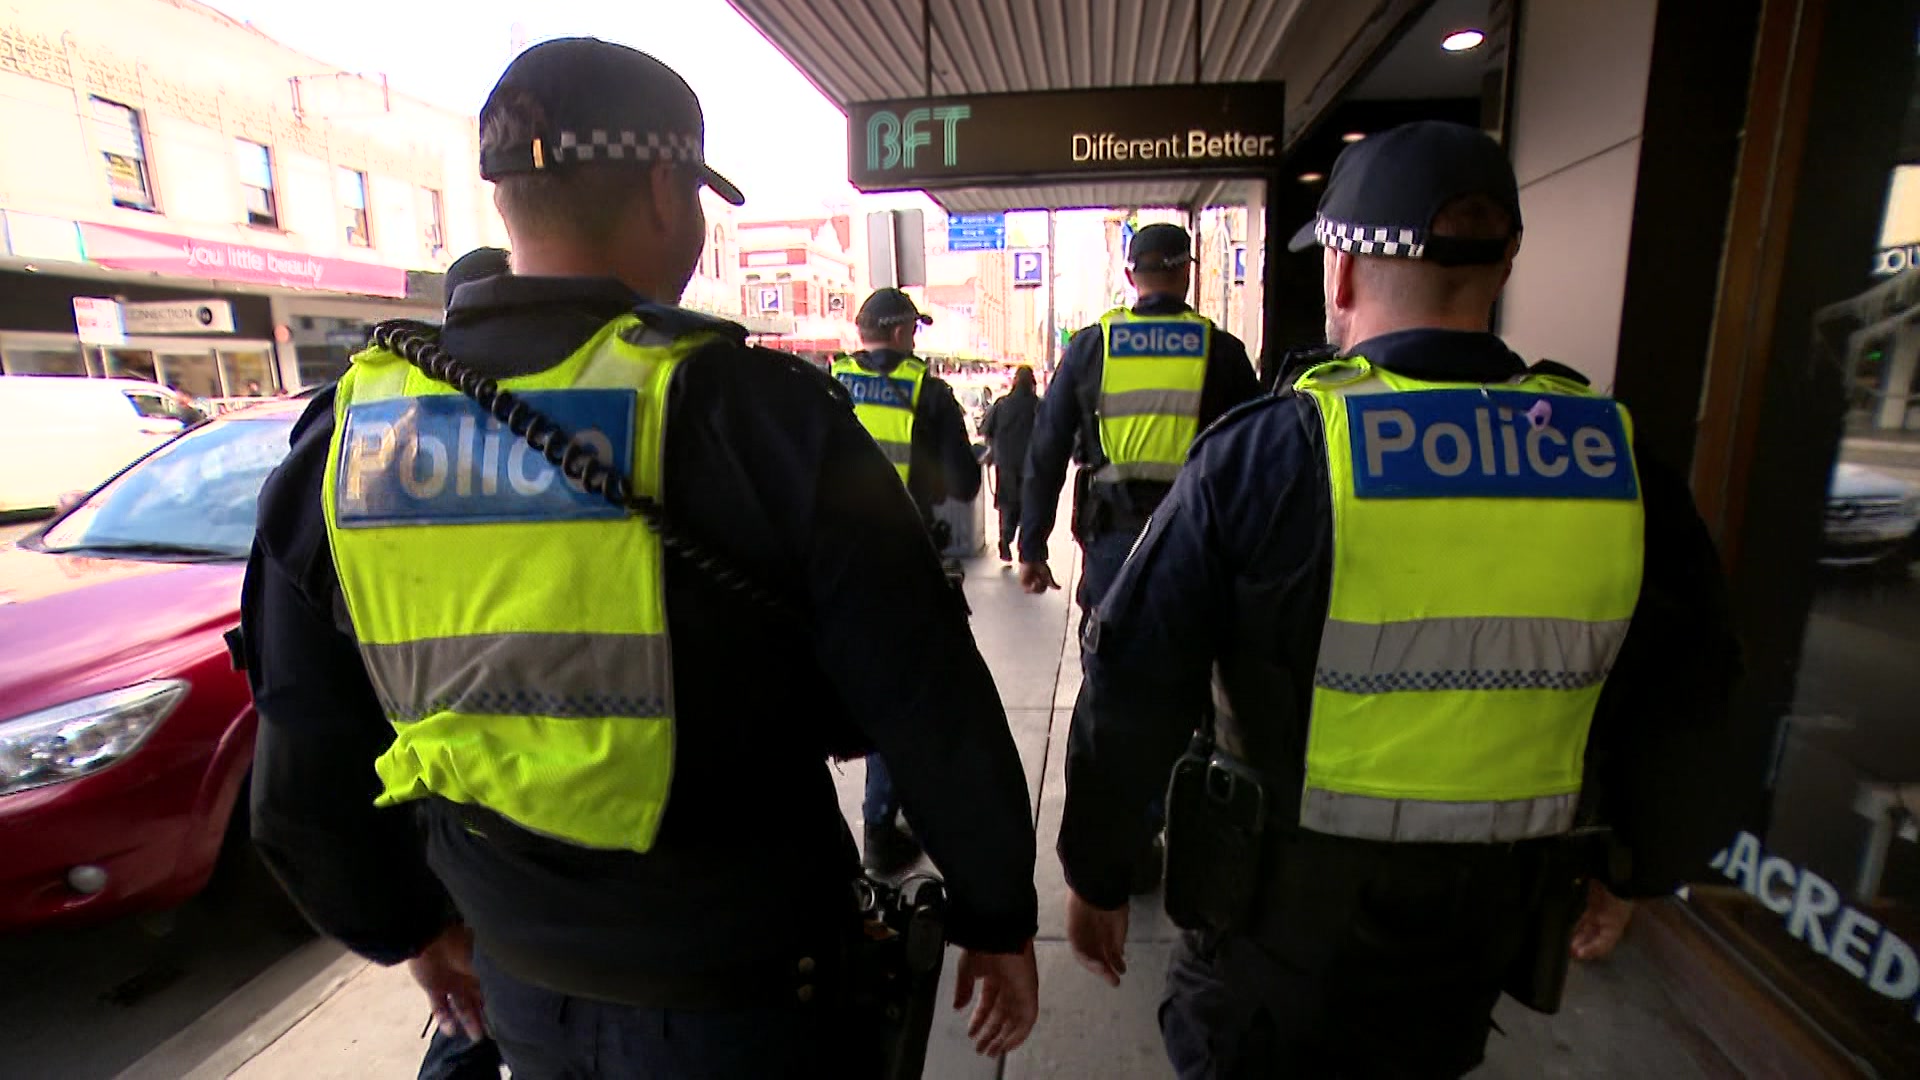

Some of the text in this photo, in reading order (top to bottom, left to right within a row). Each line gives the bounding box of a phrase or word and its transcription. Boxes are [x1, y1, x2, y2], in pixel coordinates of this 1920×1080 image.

[867, 105, 970, 170] BFT
[183, 244, 324, 281] you little beauty
[1018, 254, 1038, 280] P
[763, 291, 777, 309] P
[1112, 327, 1200, 352] Police
[1362, 406, 1617, 478] Police
[1709, 831, 1920, 999] ACRED
